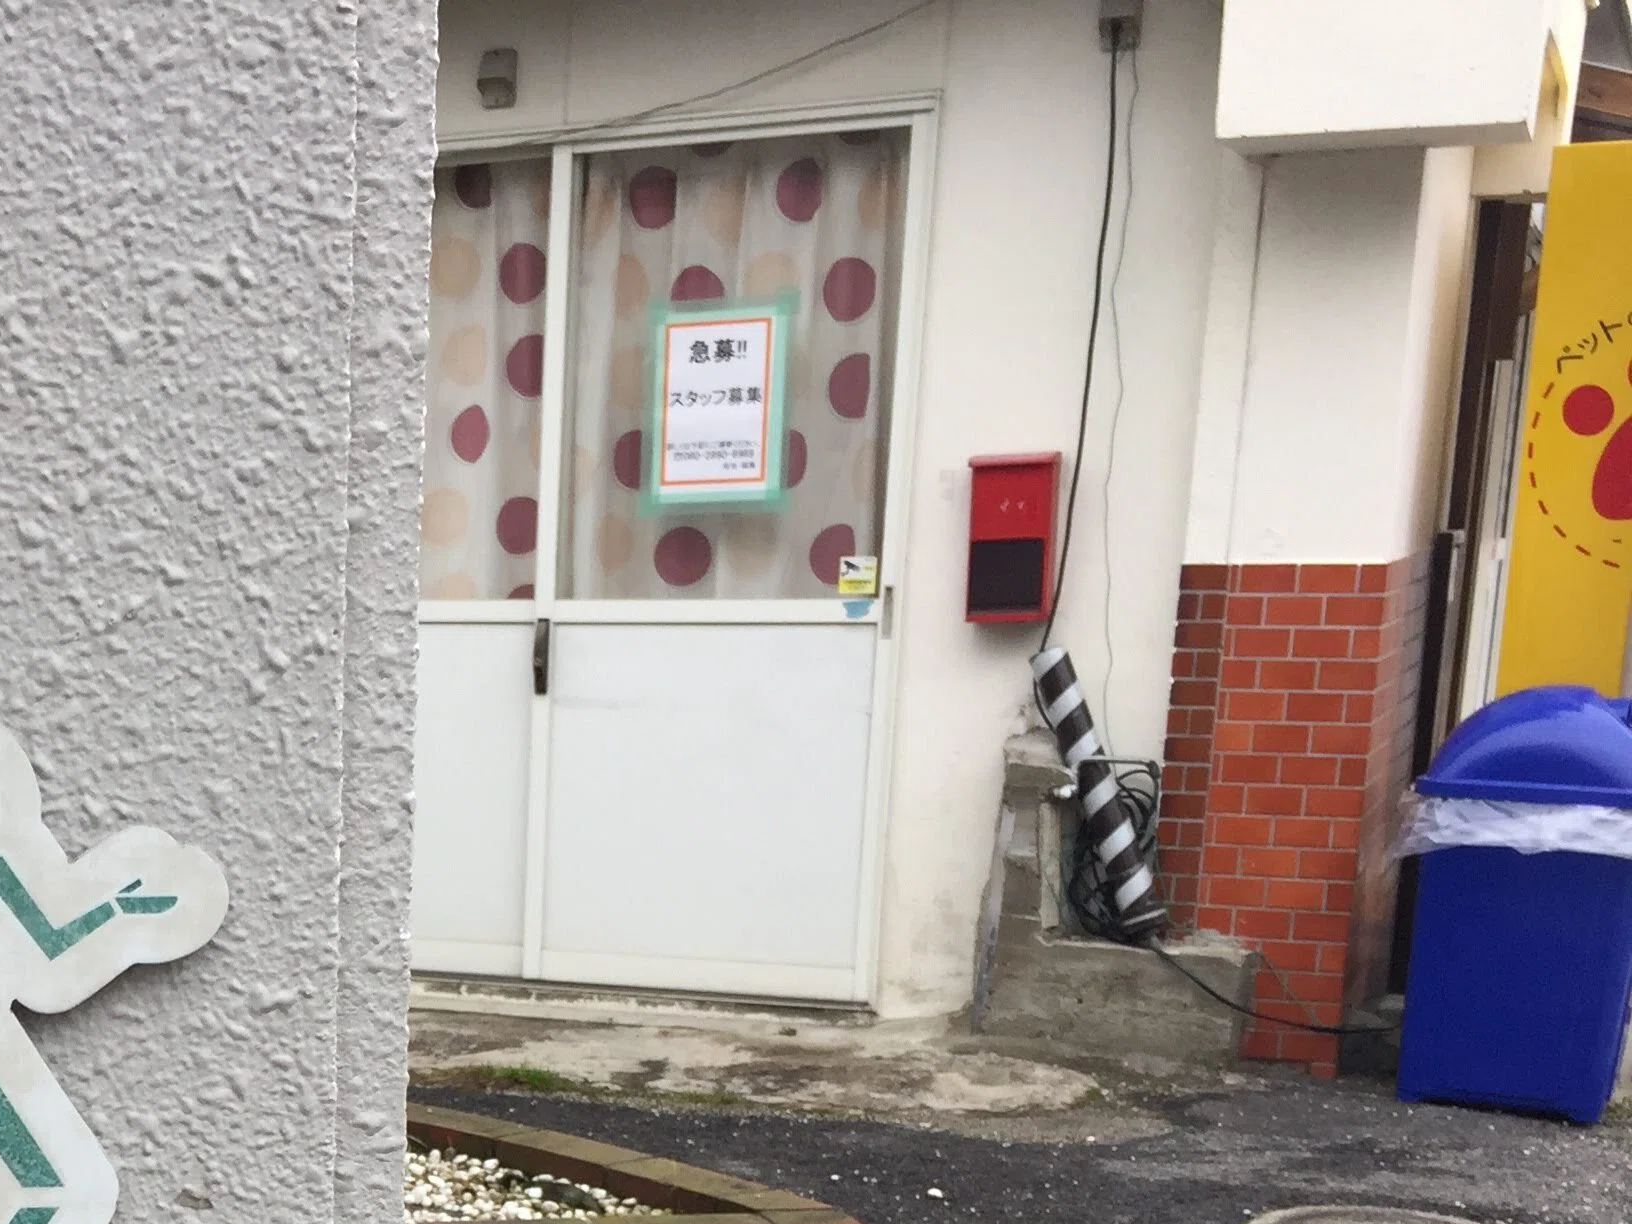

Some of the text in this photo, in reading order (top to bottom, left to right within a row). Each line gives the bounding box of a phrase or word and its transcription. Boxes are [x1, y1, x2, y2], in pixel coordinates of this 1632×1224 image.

[670, 386, 762, 408] スタッフ募集
